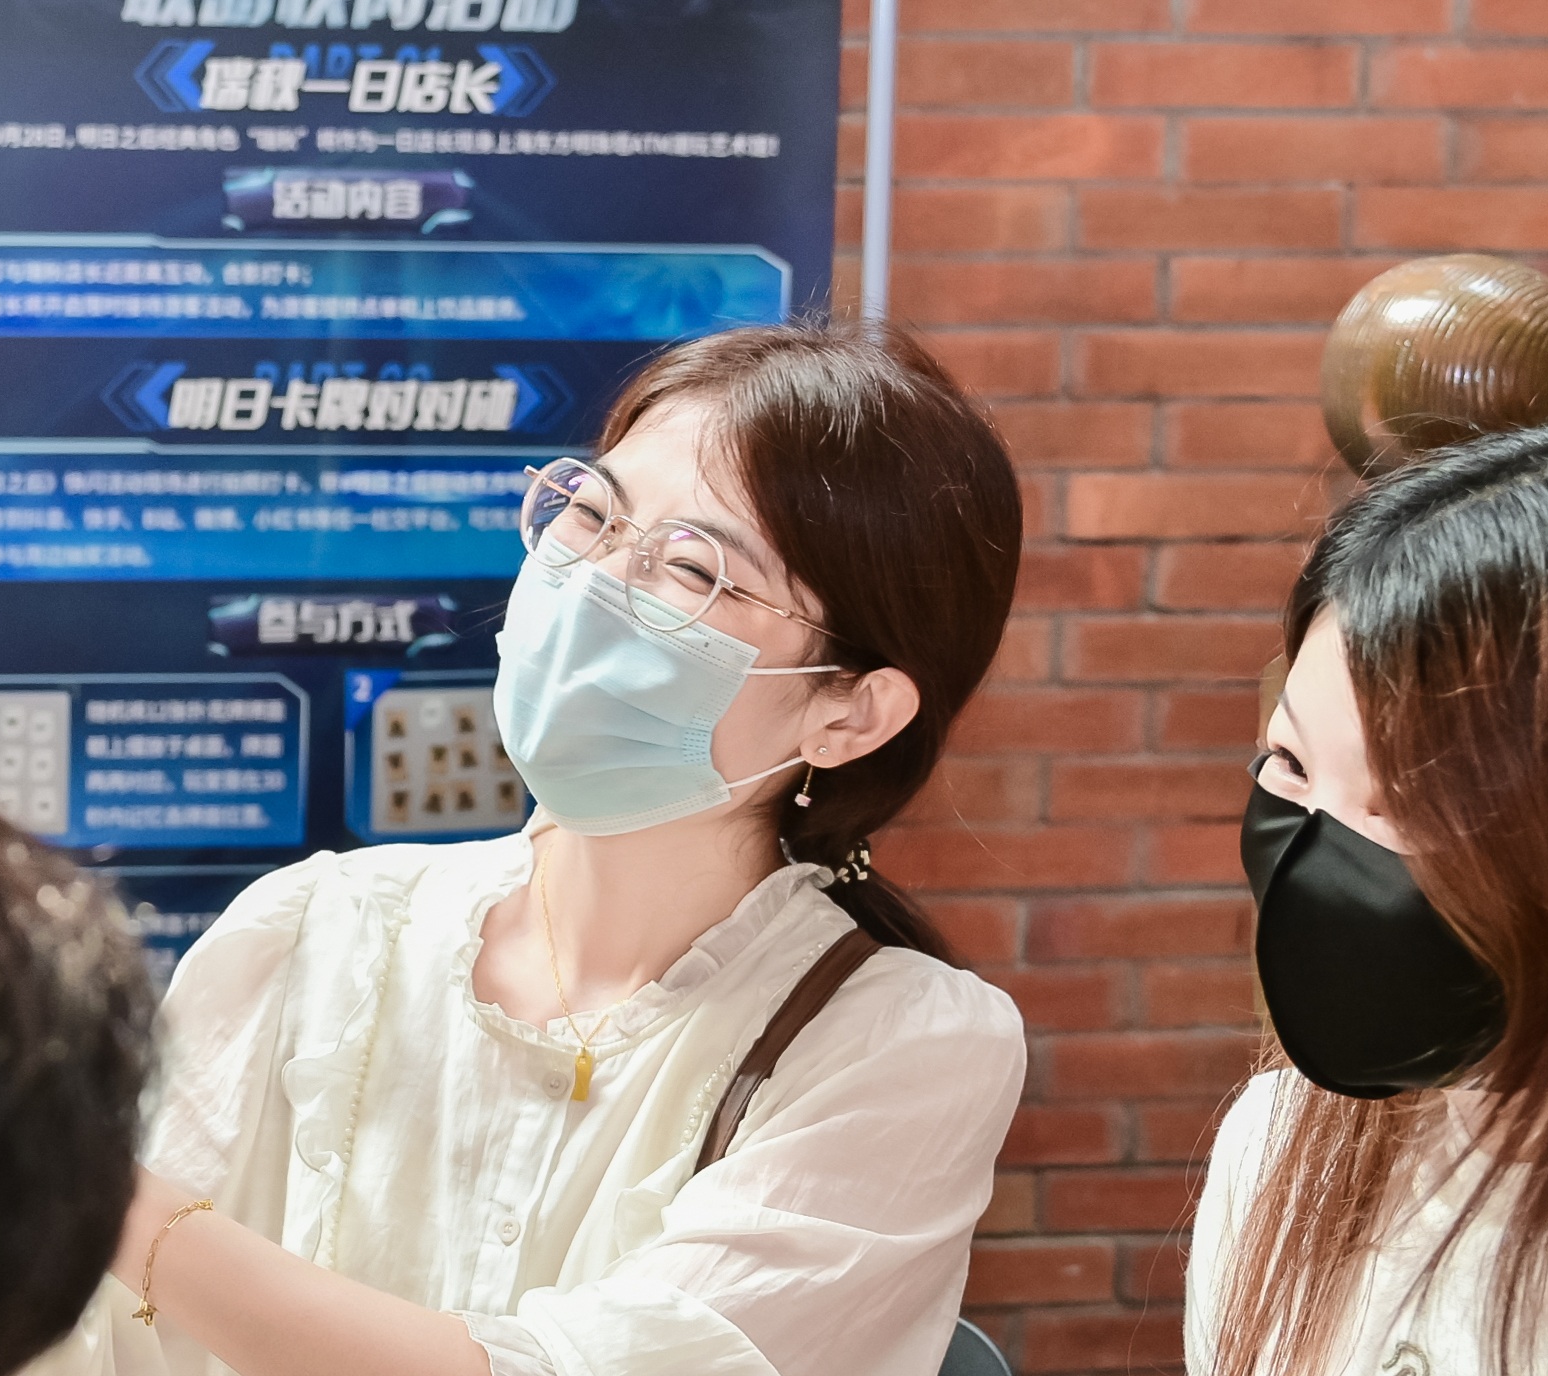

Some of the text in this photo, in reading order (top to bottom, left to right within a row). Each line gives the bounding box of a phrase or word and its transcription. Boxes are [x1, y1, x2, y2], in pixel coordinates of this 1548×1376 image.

[199, 56, 502, 115] 瑞秋一日店长
[272, 177, 423, 220] 活动内容
[168, 377, 519, 432] 明日卡牌对对碰
[257, 599, 418, 644] 参与方式
[354, 674, 373, 703] 2
